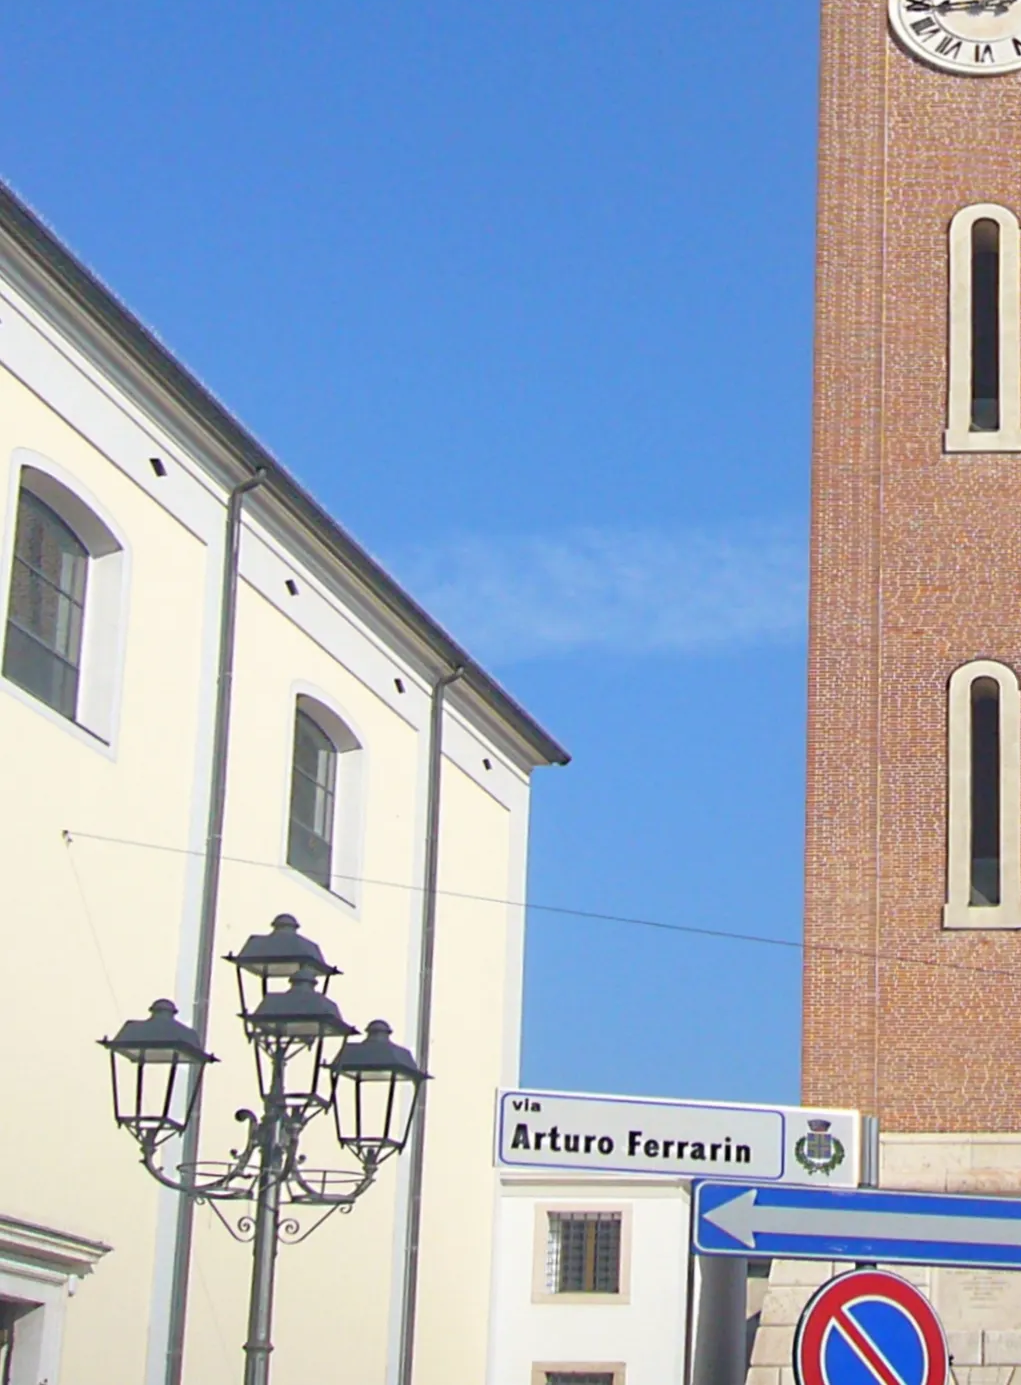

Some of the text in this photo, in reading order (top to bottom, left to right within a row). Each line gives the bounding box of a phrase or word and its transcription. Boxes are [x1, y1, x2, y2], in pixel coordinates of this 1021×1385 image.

[975, 44, 995, 63] VI
[512, 1098, 541, 1112] via
[510, 1123, 751, 1163] Arturo Ferrarin
